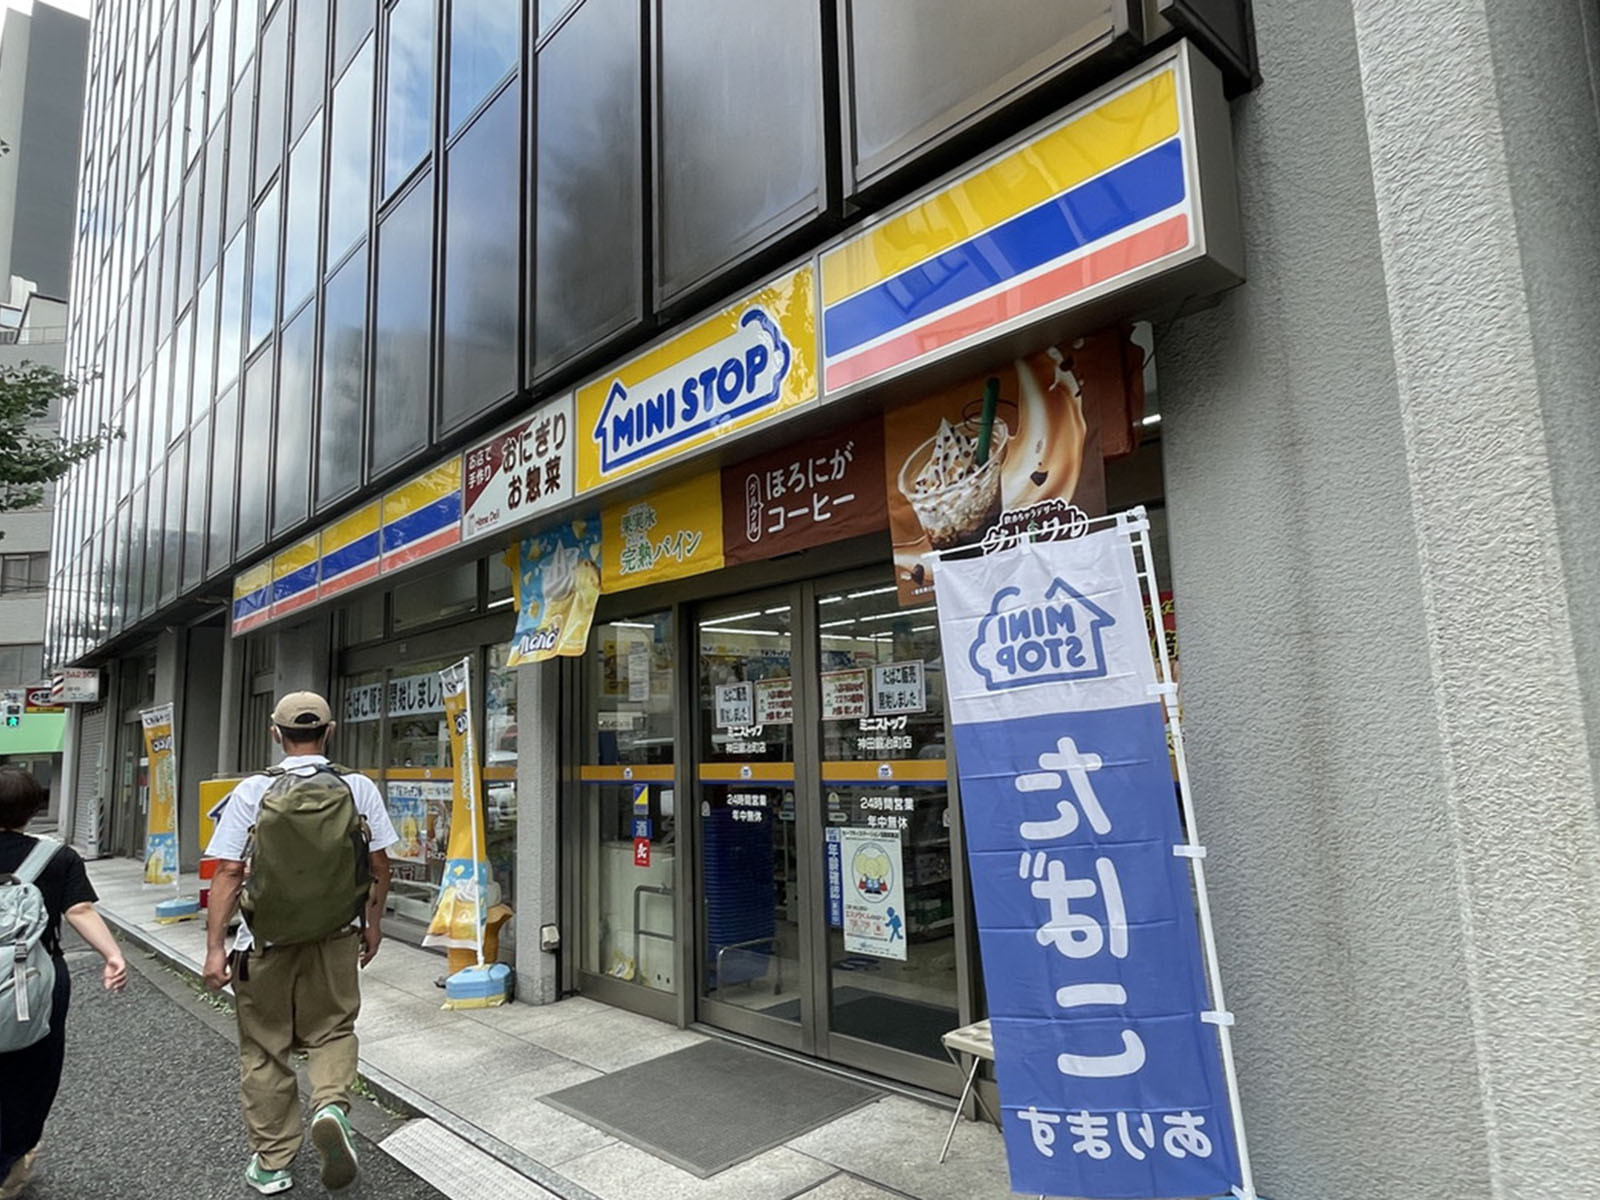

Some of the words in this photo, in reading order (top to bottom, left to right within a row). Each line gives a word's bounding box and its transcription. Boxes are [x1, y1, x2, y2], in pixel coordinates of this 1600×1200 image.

[613, 387, 675, 452] MINI
[681, 344, 768, 422] STOP
[501, 411, 567, 474] おにぎり
[507, 455, 562, 511] お惣菜
[766, 441, 854, 500] ほろにが
[767, 493, 855, 533] コーヒー
[727, 724, 763, 738] ミニストップ
[859, 715, 908, 731] ミニストップ
[726, 793, 767, 807] 24時間営業
[860, 796, 915, 812] 24時間営業
[866, 815, 909, 830] 年中無休
